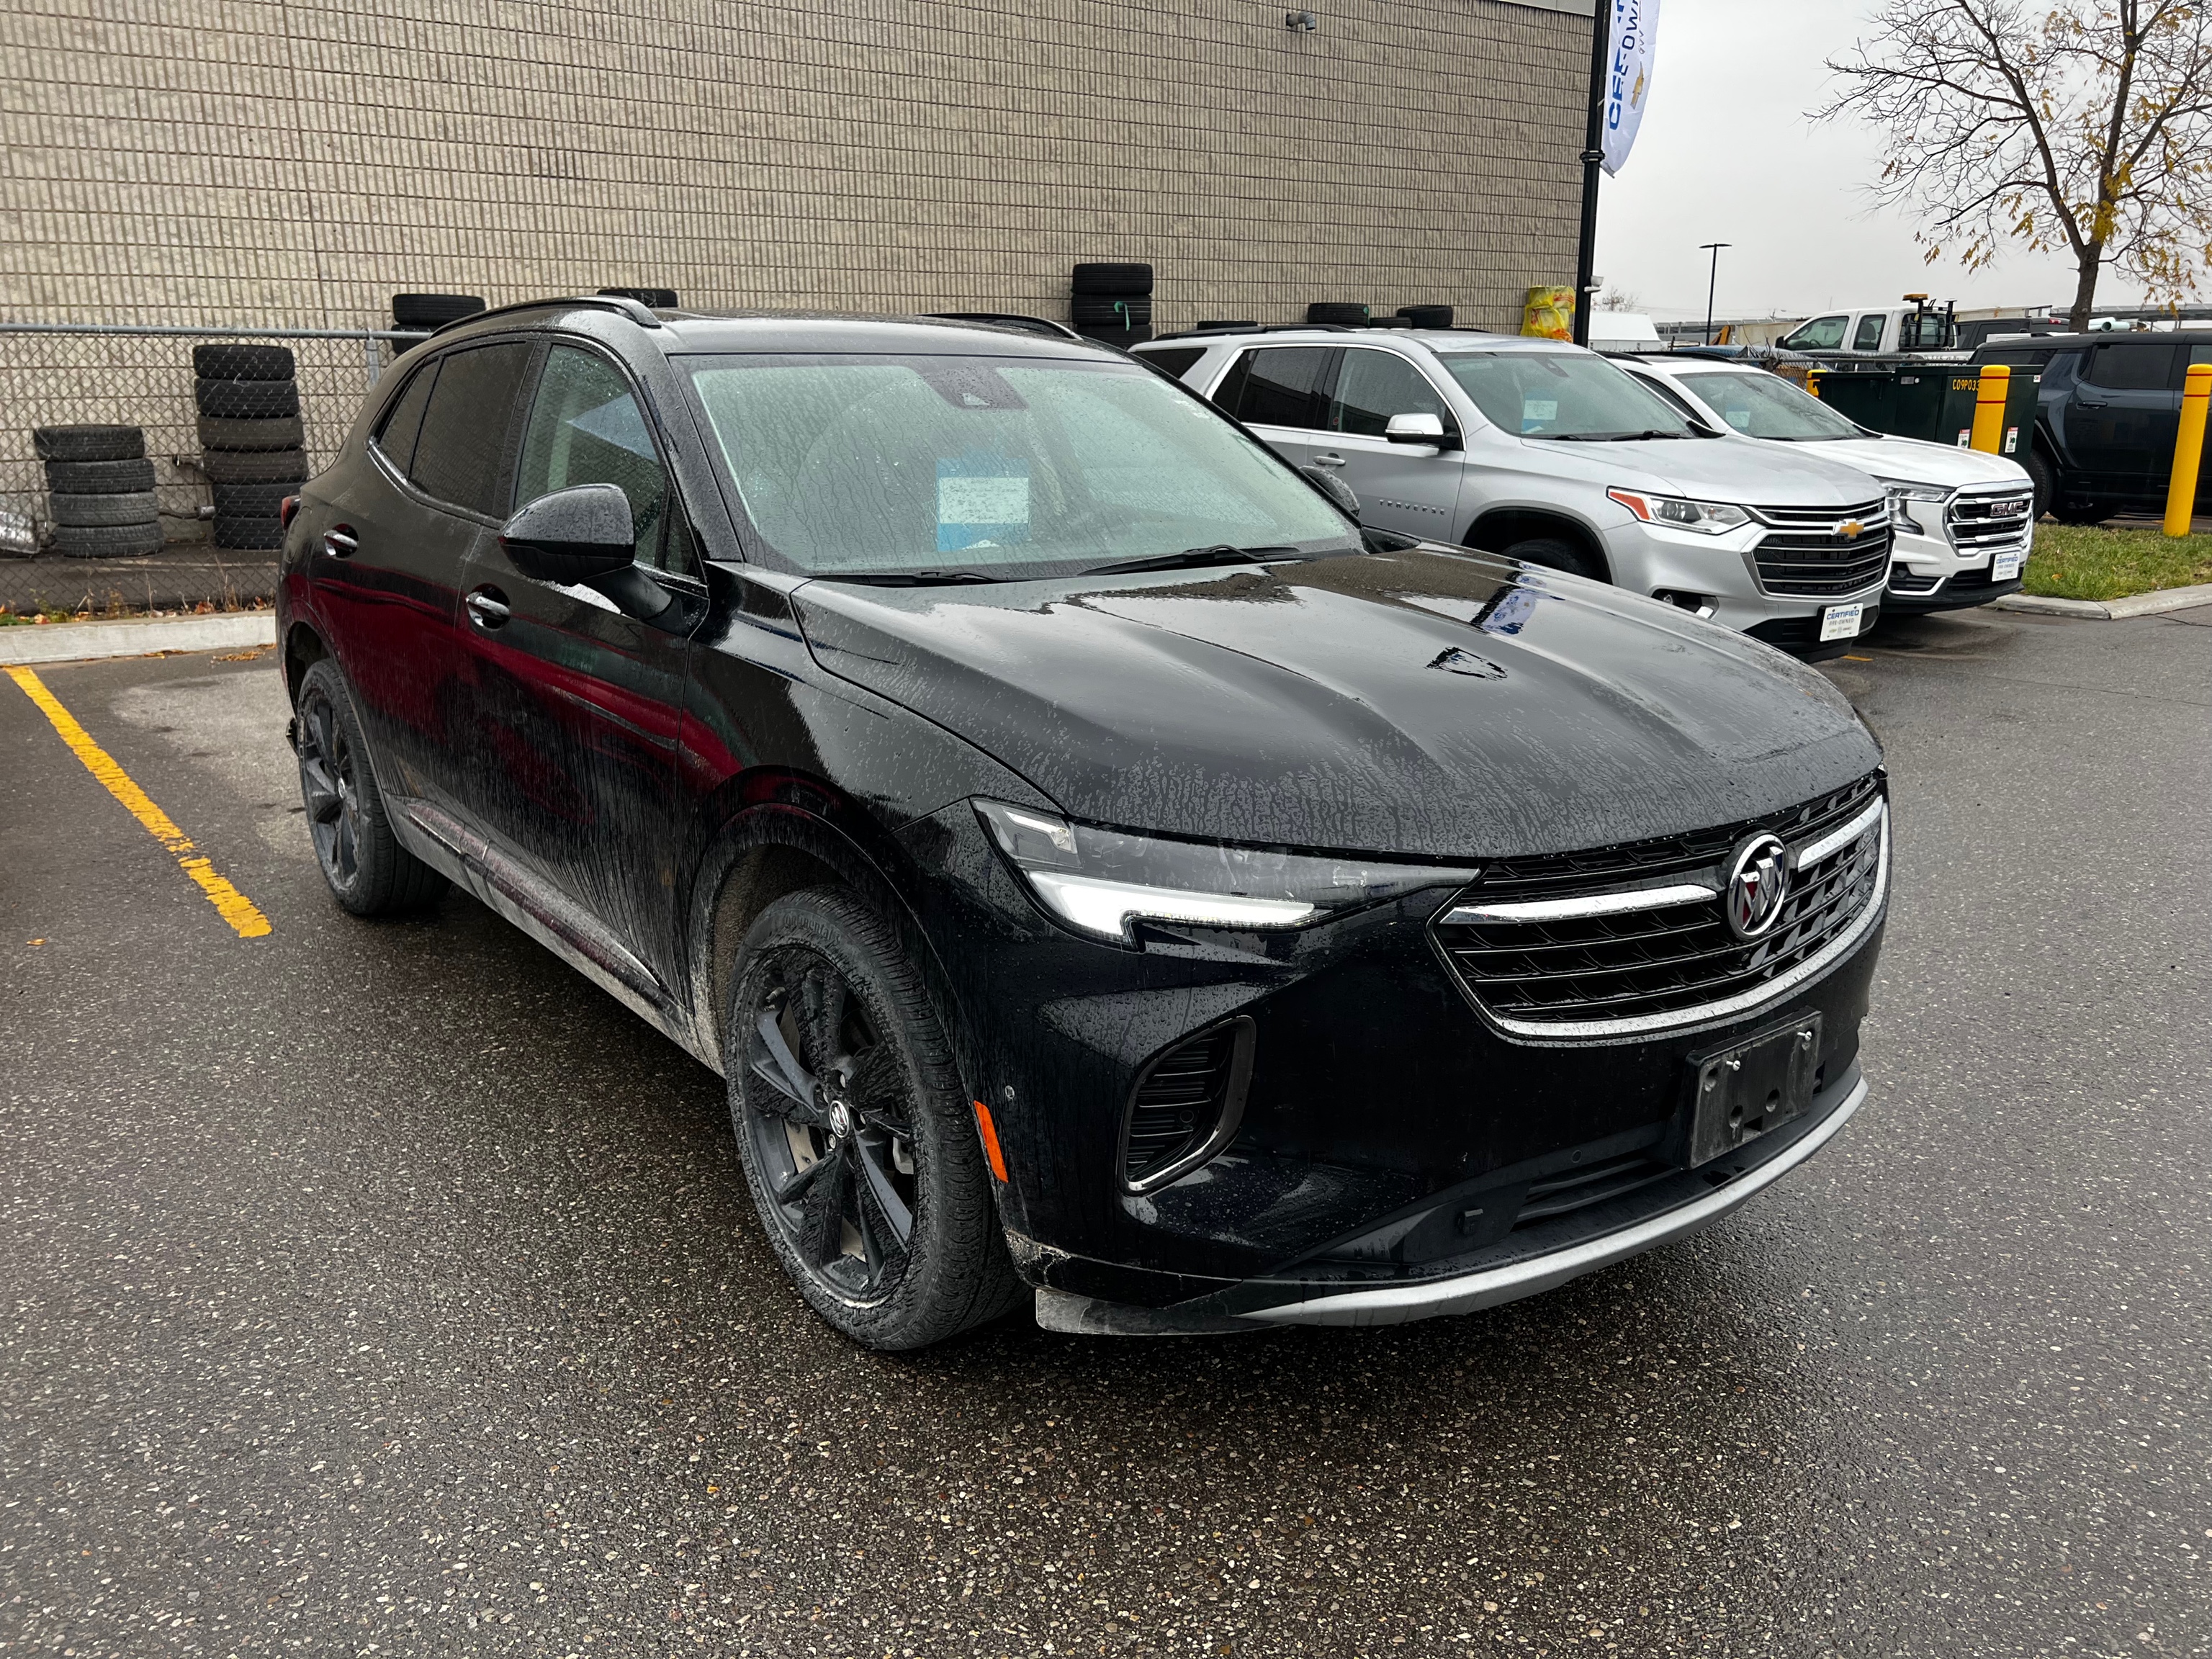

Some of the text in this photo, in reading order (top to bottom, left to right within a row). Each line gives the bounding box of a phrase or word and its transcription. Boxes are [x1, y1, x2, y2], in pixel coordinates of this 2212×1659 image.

[1379, 499, 1445, 516] TRAVERSE
[1990, 501, 2023, 516] GMC
[1826, 609, 1860, 620] CERTIFIED
